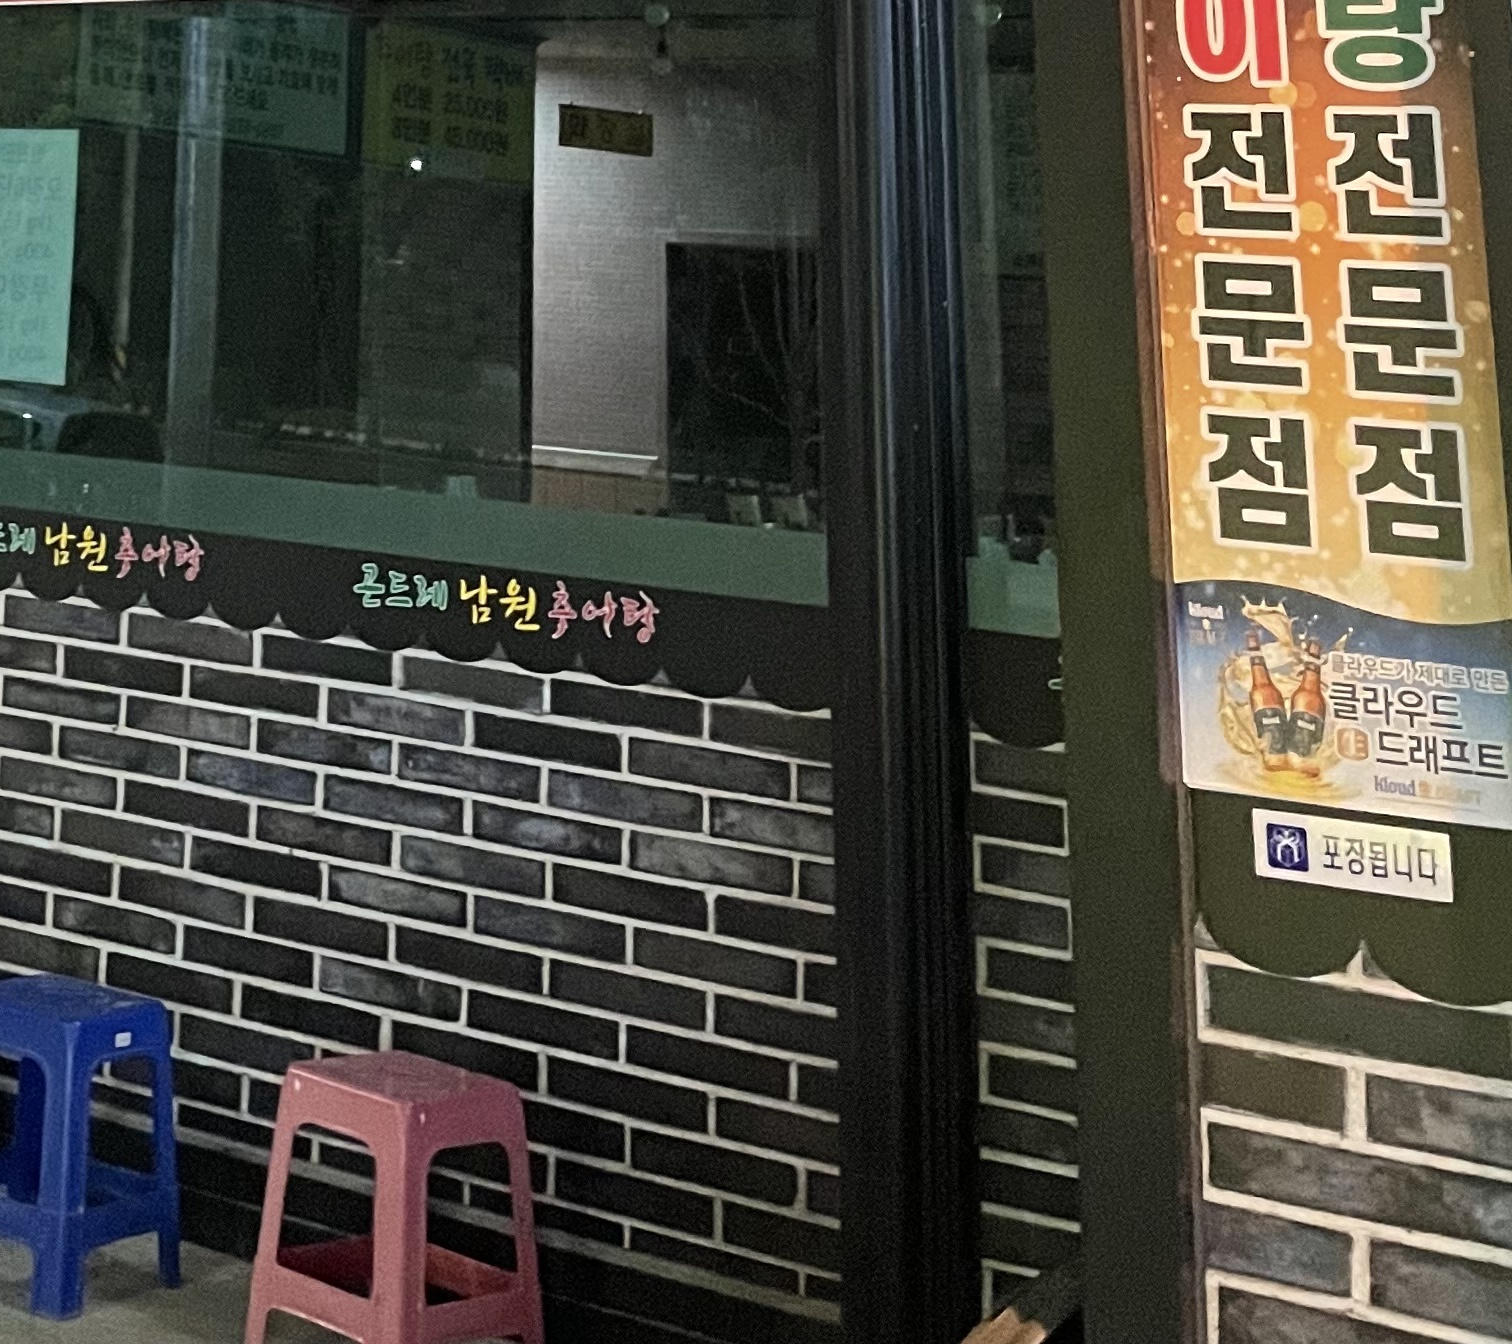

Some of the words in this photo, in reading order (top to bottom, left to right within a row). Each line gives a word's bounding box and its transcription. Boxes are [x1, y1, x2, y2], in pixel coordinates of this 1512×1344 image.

[45, 521, 109, 572] 남원
[115, 526, 205, 581] 추어탕
[353, 563, 449, 611] 곤드레
[459, 574, 541, 631] 남원
[548, 580, 660, 644] 추어탕
[1329, 681, 1464, 729] 클라우드
[1376, 730, 1509, 780] 드래프트
[1321, 833, 1439, 887] 포장됩니다
